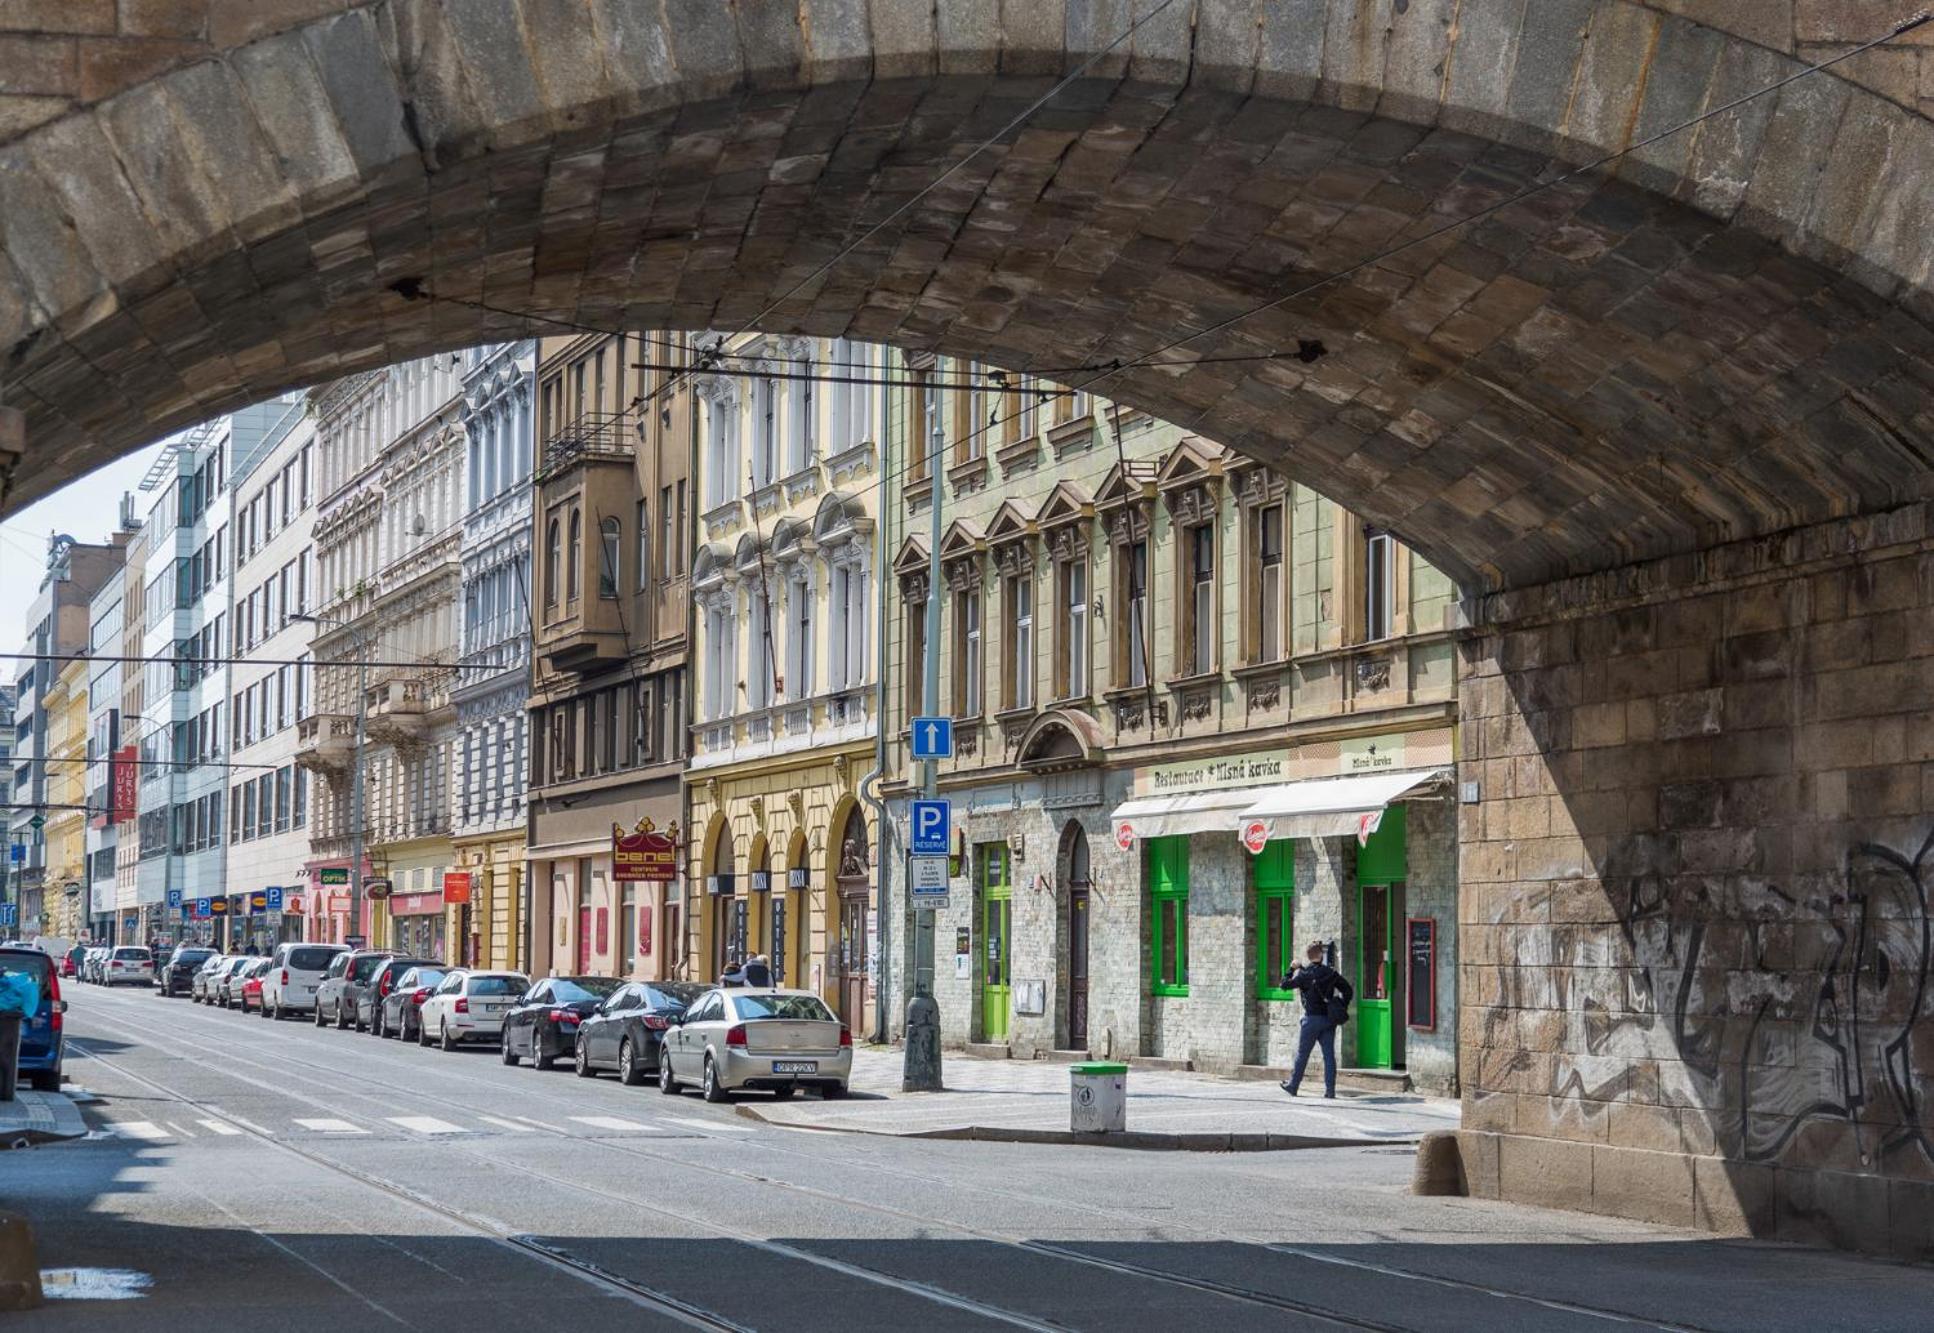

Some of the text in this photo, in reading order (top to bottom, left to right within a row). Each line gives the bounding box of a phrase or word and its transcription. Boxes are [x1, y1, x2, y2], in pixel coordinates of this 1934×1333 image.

[1154, 769, 1204, 788] Restaurace
[1248, 758, 1281, 778] kavka
[920, 807, 941, 837] P
[200, 901, 208, 911] P
[269, 889, 280, 902] P
